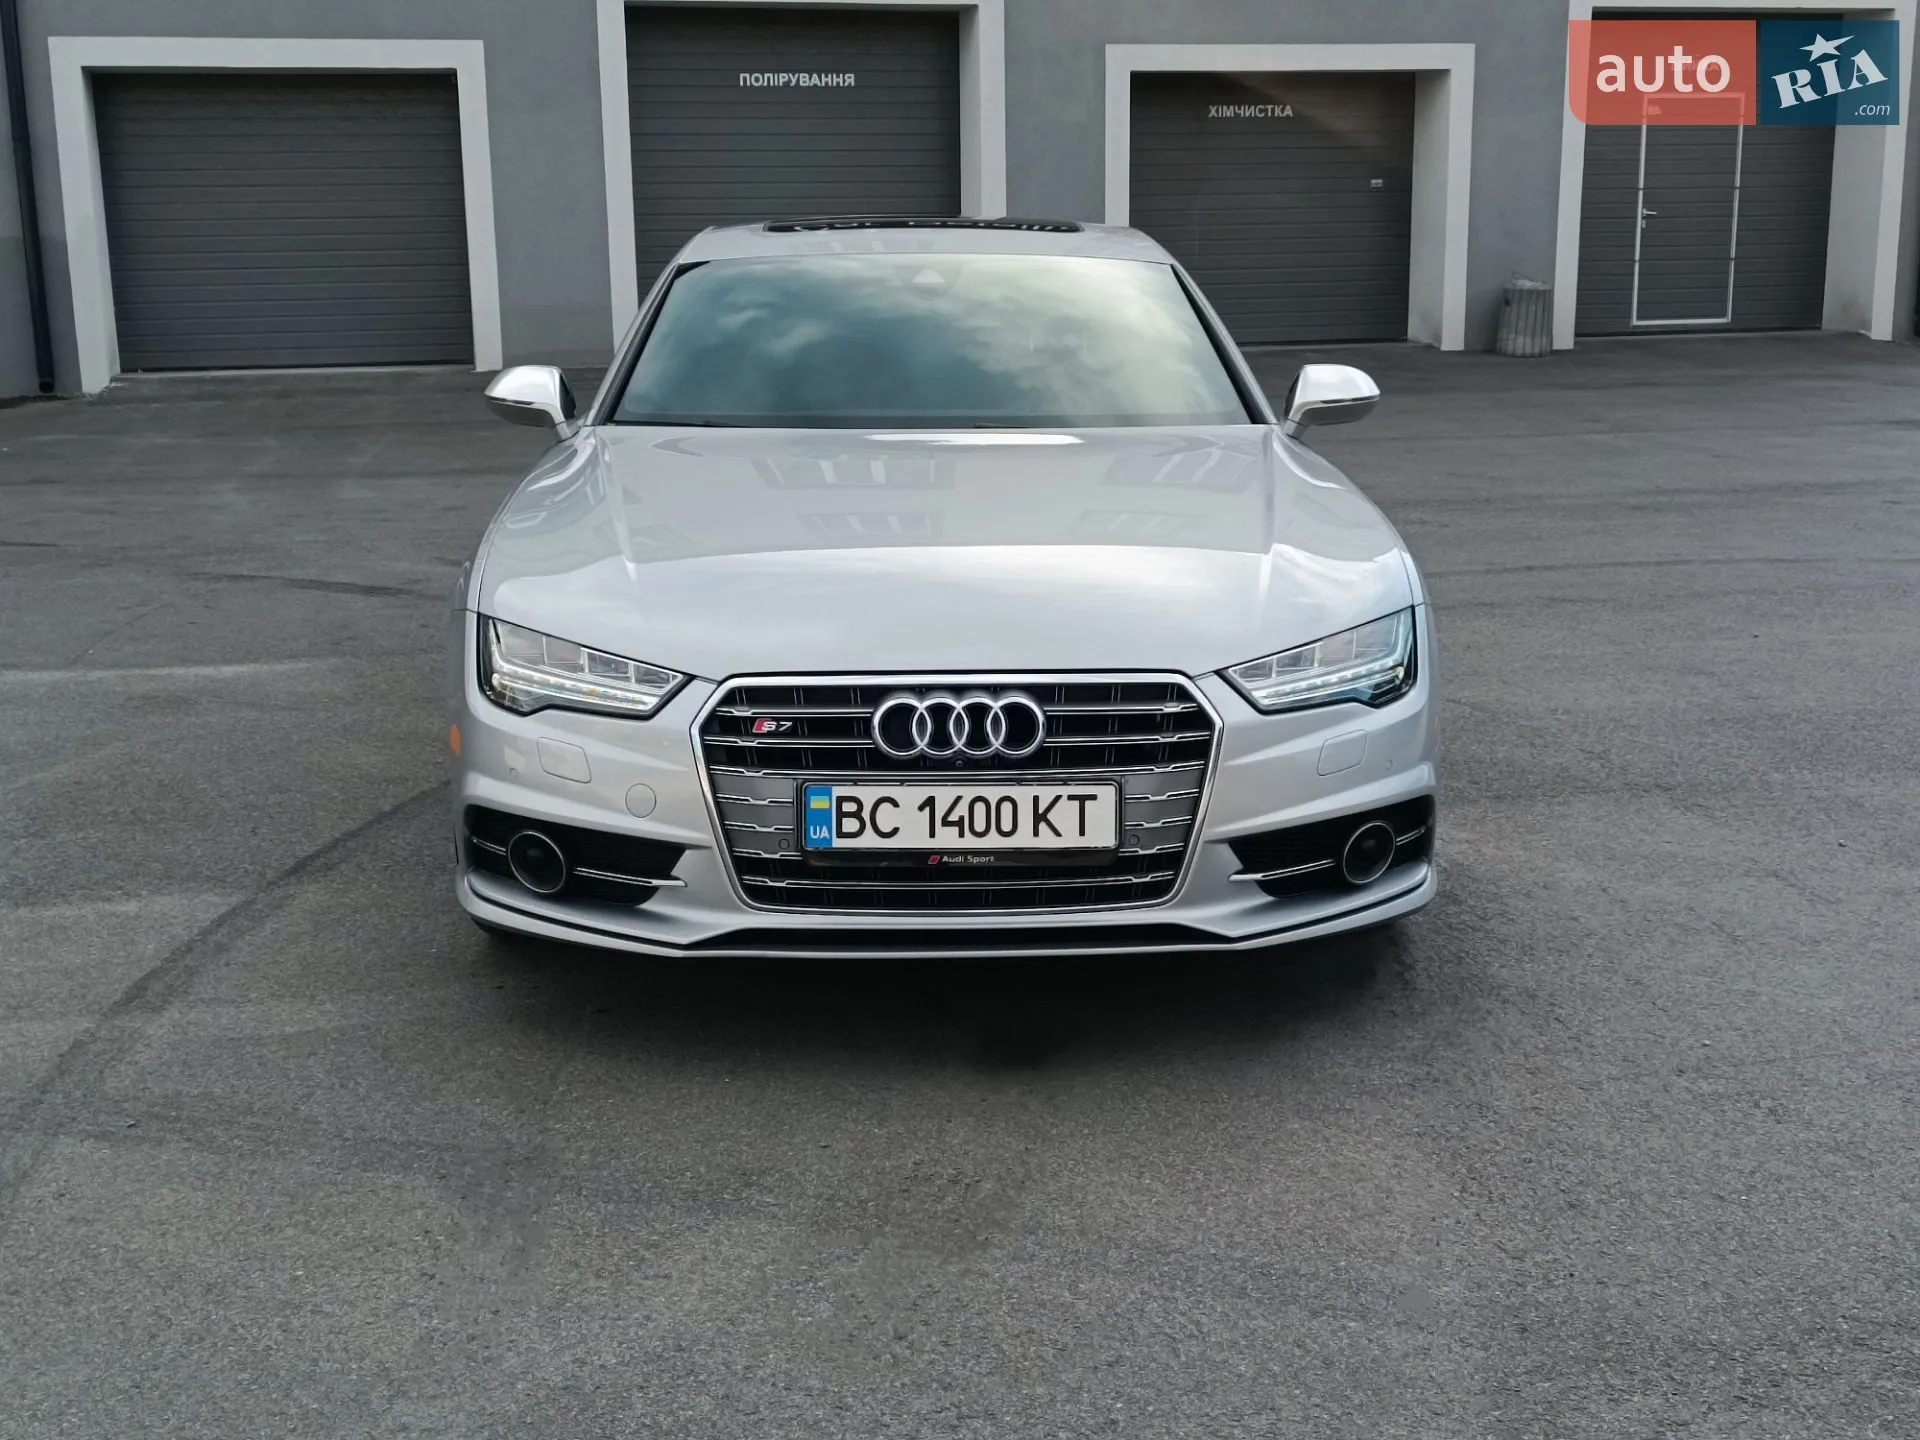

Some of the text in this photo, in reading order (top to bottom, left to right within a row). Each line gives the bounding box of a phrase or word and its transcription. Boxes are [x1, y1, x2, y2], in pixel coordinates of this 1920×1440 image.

[739, 73, 856, 87] ПОЛІРУВАННЯ
[1208, 104, 1294, 118] ХІМЧИСТКА
[762, 721, 793, 731] S7
[835, 793, 1098, 839] BC 1400 KT
[810, 825, 830, 840] UA
[941, 855, 995, 864] Audi Sport
